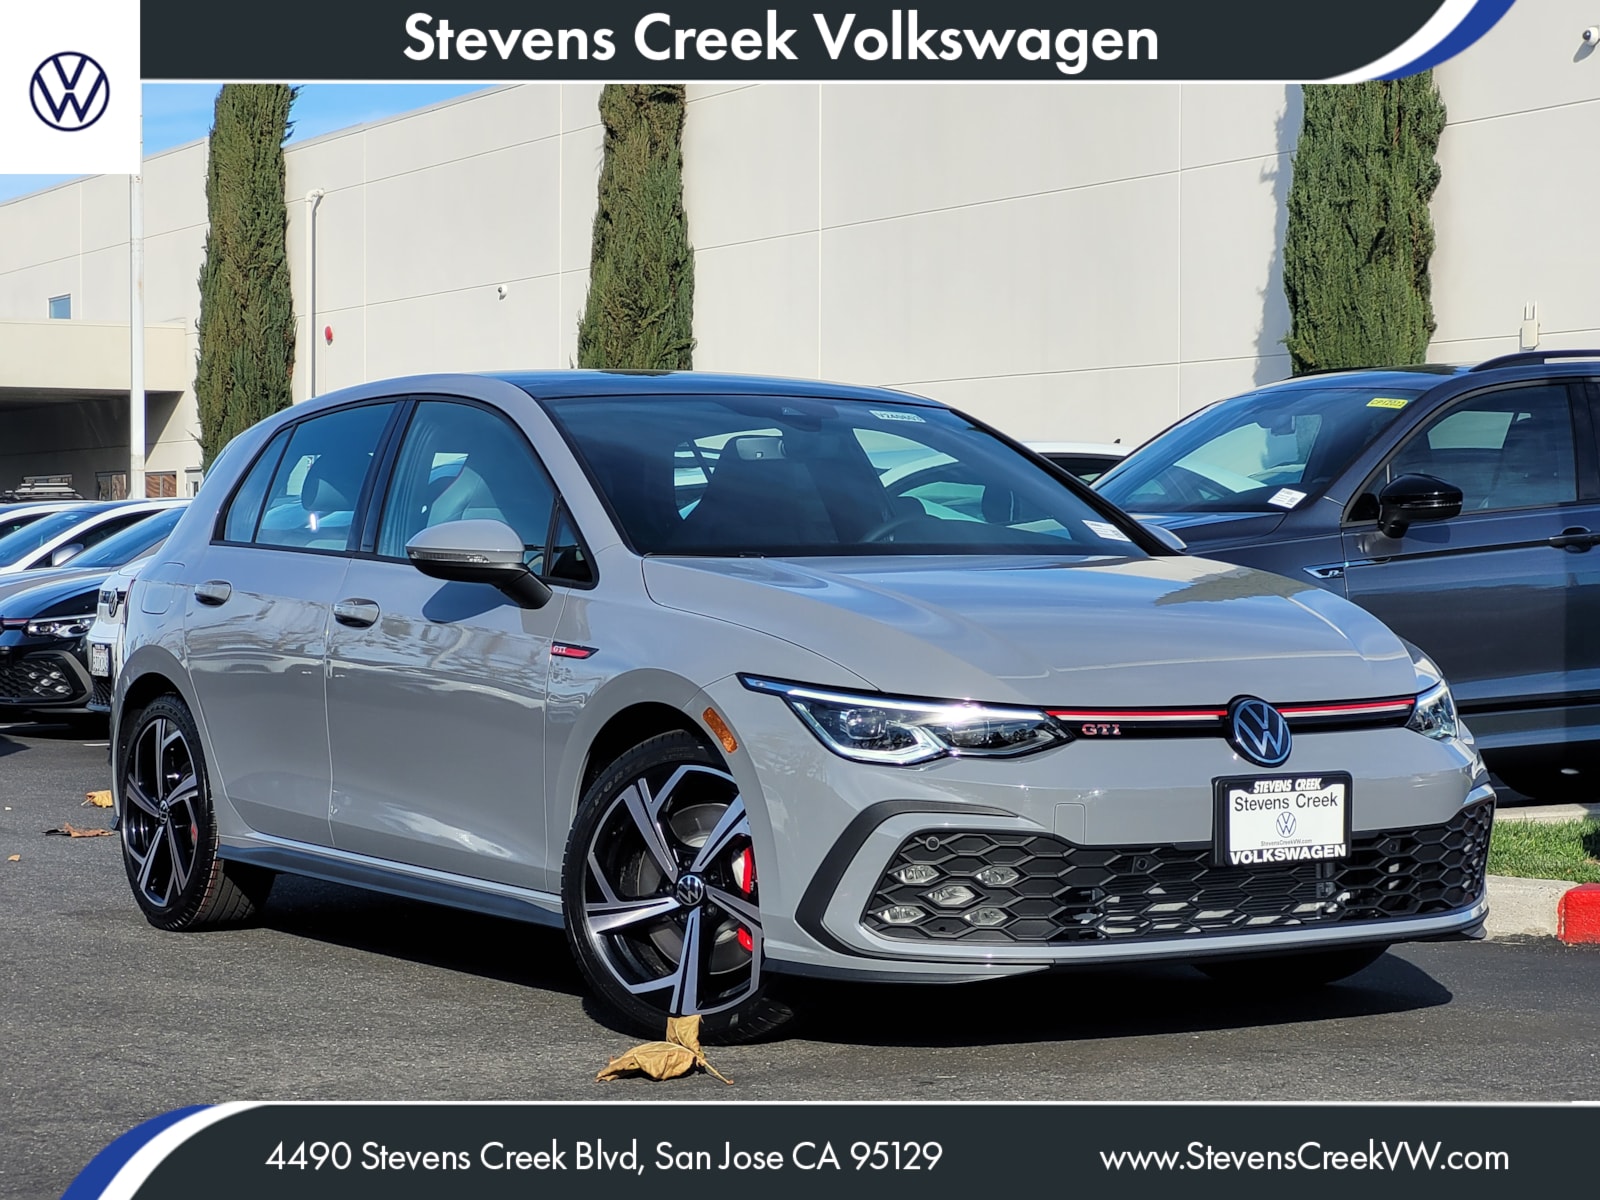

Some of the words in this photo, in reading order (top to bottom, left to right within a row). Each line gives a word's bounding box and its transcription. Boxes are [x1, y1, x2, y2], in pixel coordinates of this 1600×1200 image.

[553, 645, 567, 653] GTI
[1081, 723, 1122, 736] GTI
[1253, 779, 1292, 794] STEVENS
[1295, 778, 1322, 791] CREEK
[1234, 796, 1290, 812] Stevens
[1295, 792, 1338, 808] Creek
[1230, 844, 1346, 865] VOLKSWAGEN
